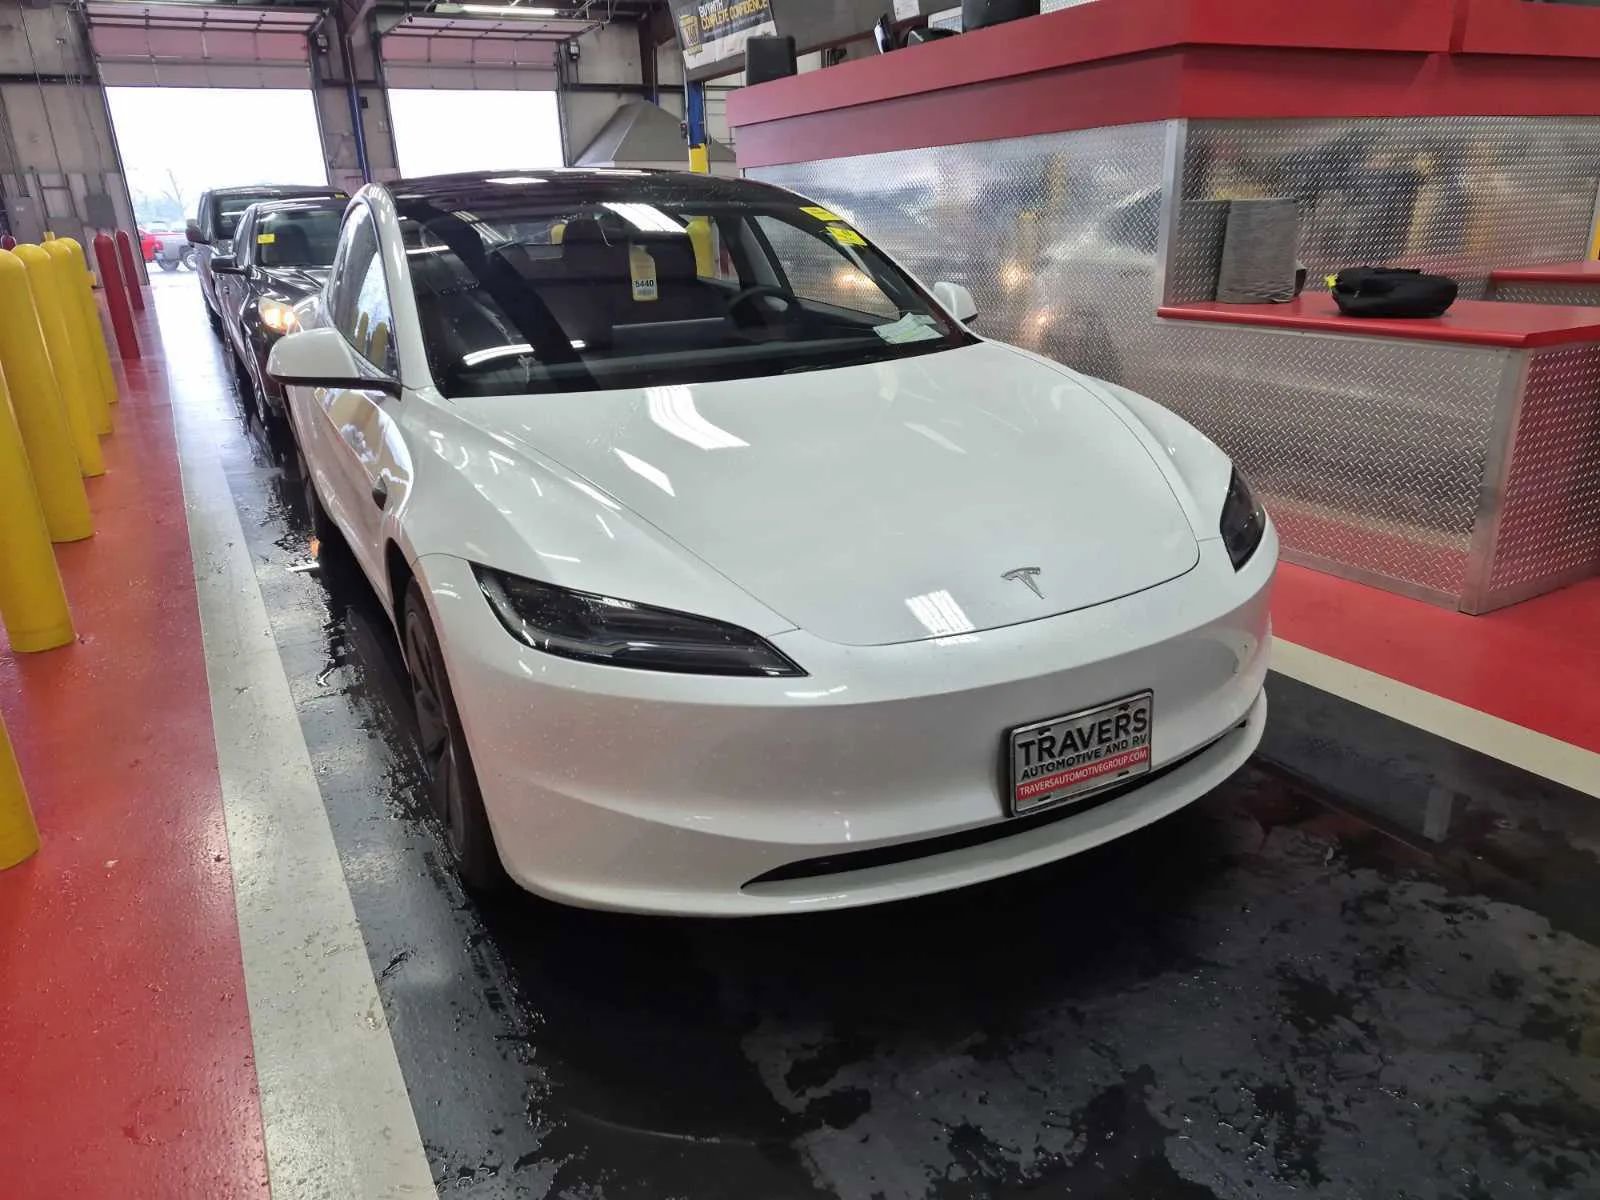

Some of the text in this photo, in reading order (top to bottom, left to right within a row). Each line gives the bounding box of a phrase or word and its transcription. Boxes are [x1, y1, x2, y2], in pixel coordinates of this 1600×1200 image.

[701, 8, 730, 31] COMPLETE
[730, 0, 768, 20] CONFIDENCE
[1017, 707, 1148, 766] TRAVERS
[1021, 734, 1148, 780] AUTOMOTIVE AND RV
[1019, 749, 1147, 796] TRAVERSAUTOMOTIVEGROUP.COM
